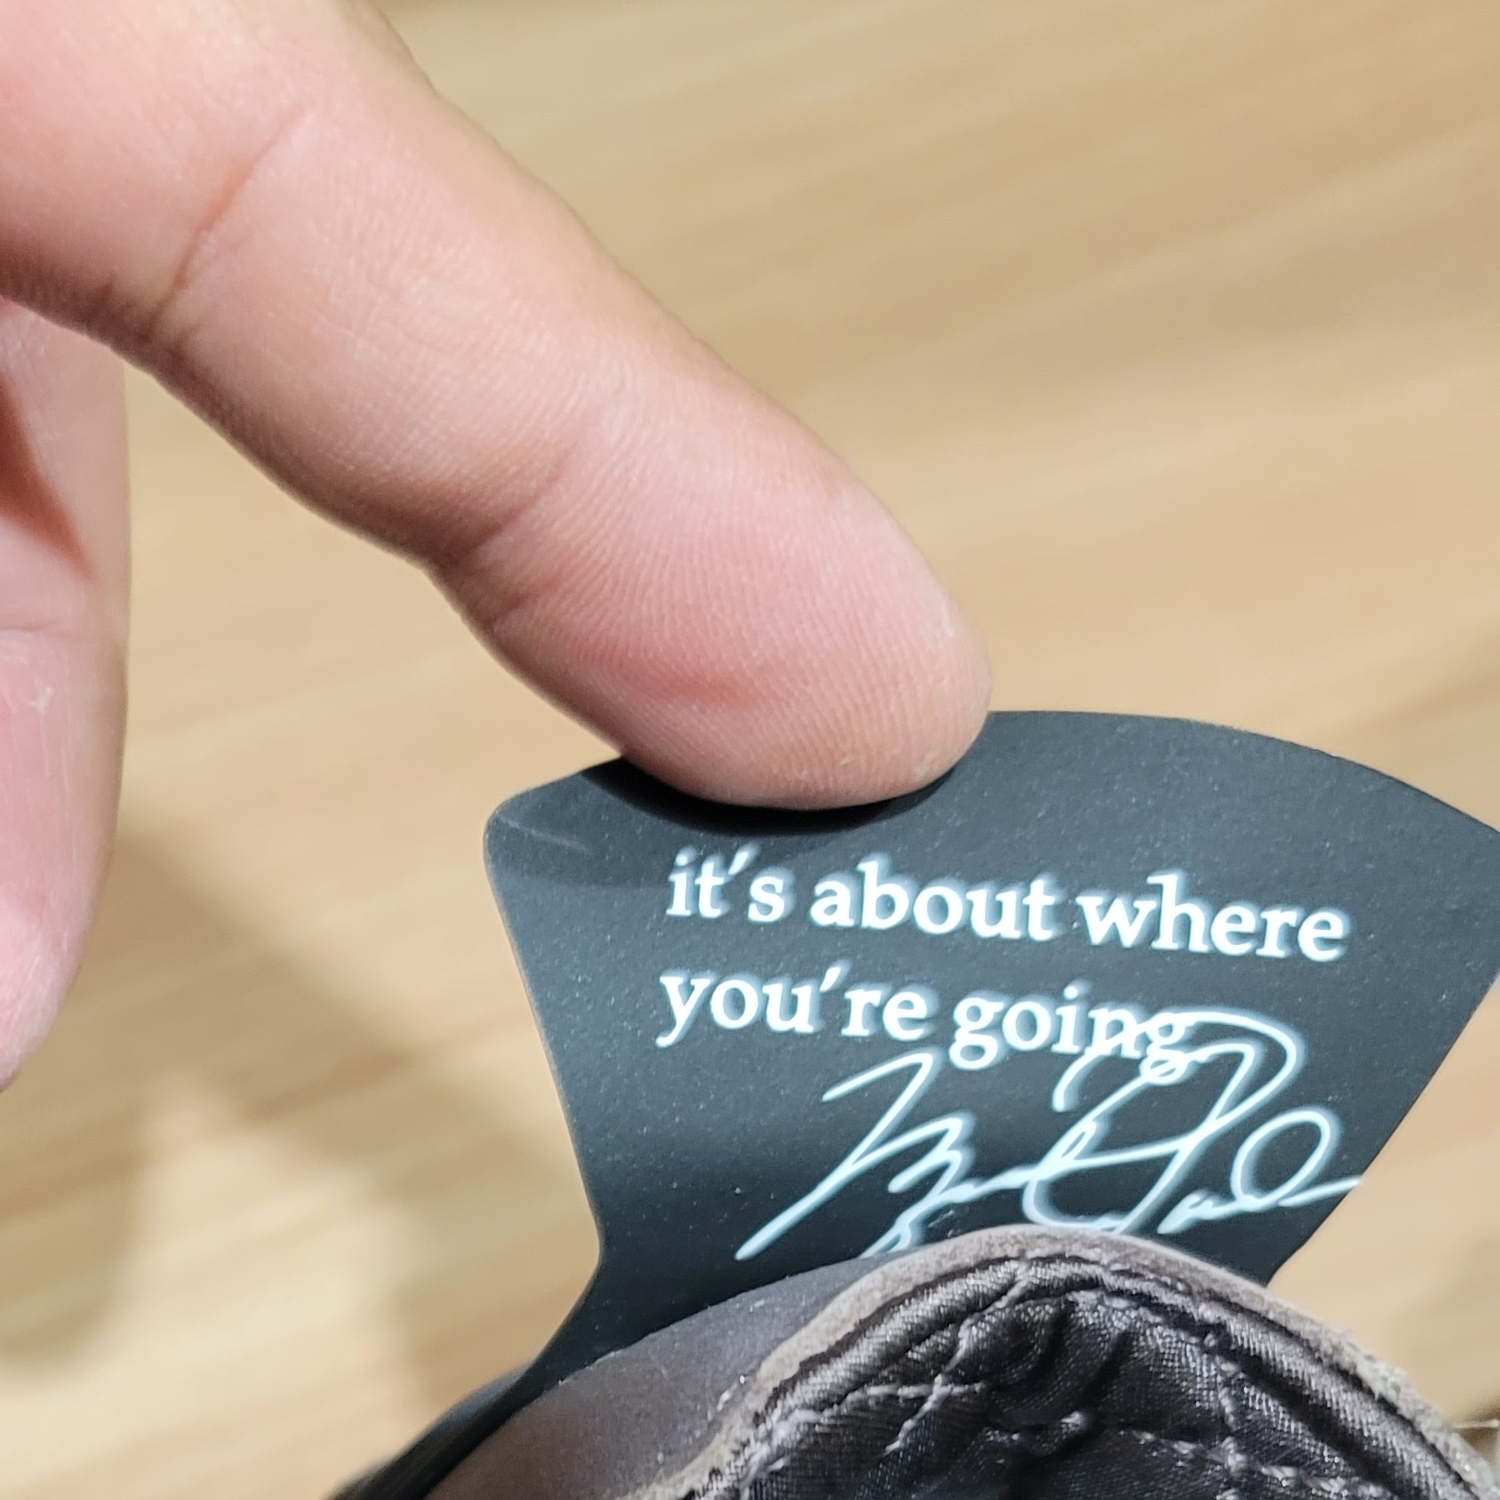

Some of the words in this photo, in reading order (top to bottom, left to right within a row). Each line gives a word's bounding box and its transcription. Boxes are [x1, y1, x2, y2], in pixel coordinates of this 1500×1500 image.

[658, 846, 792, 924] it's
[809, 853, 1058, 941] about
[1073, 869, 1351, 962] where
[654, 959, 930, 1048] you're
